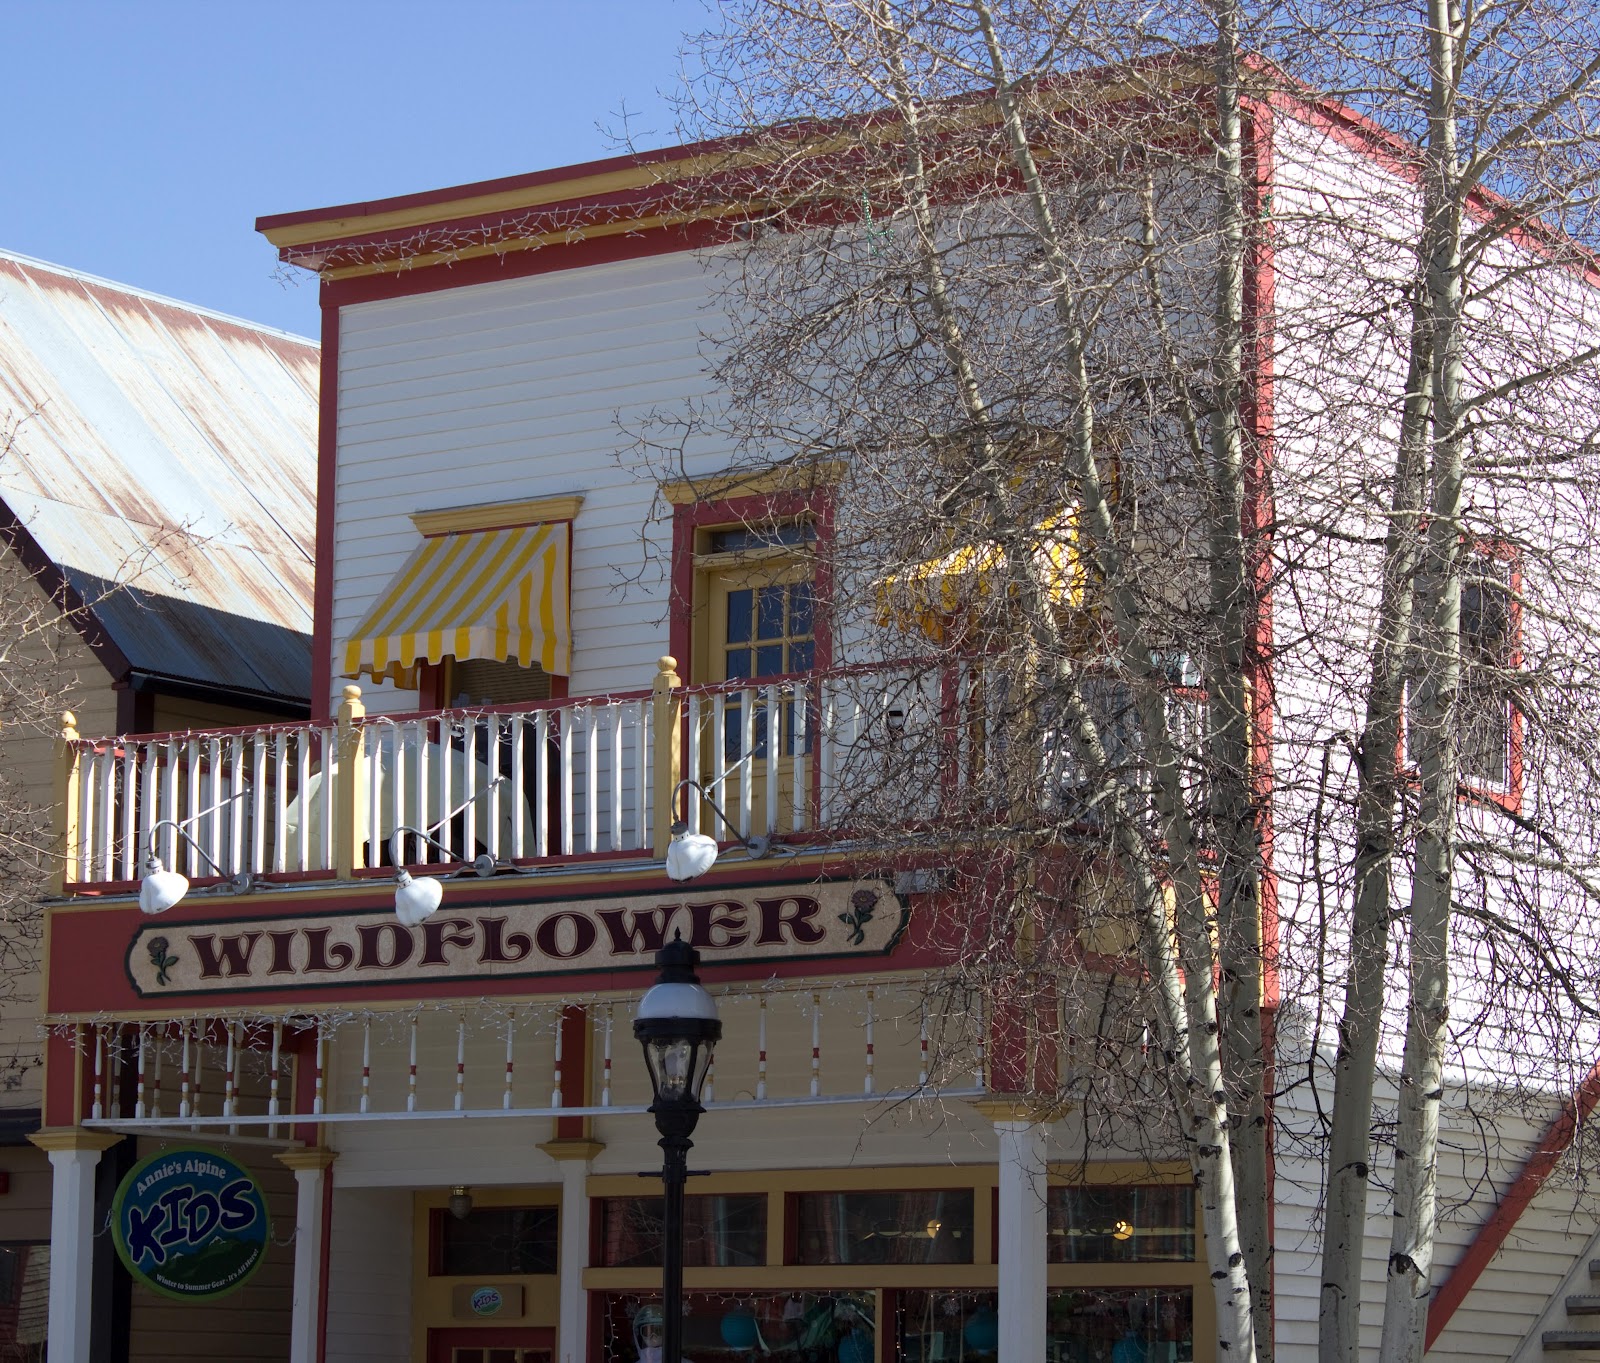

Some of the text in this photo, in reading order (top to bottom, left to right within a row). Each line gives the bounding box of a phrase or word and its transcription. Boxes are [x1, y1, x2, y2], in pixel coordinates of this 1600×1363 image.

[188, 895, 827, 979] WILDFLOWER
[136, 1159, 226, 1197] Annie's Alpine
[128, 1178, 257, 1265] KIDS
[156, 1273, 177, 1288] Winter
[185, 1283, 211, 1291] Summer
[212, 1279, 225, 1289] Gear
[228, 1273, 238, 1282] It's
[237, 1265, 247, 1276] All
[473, 1292, 499, 1309] KIDS
